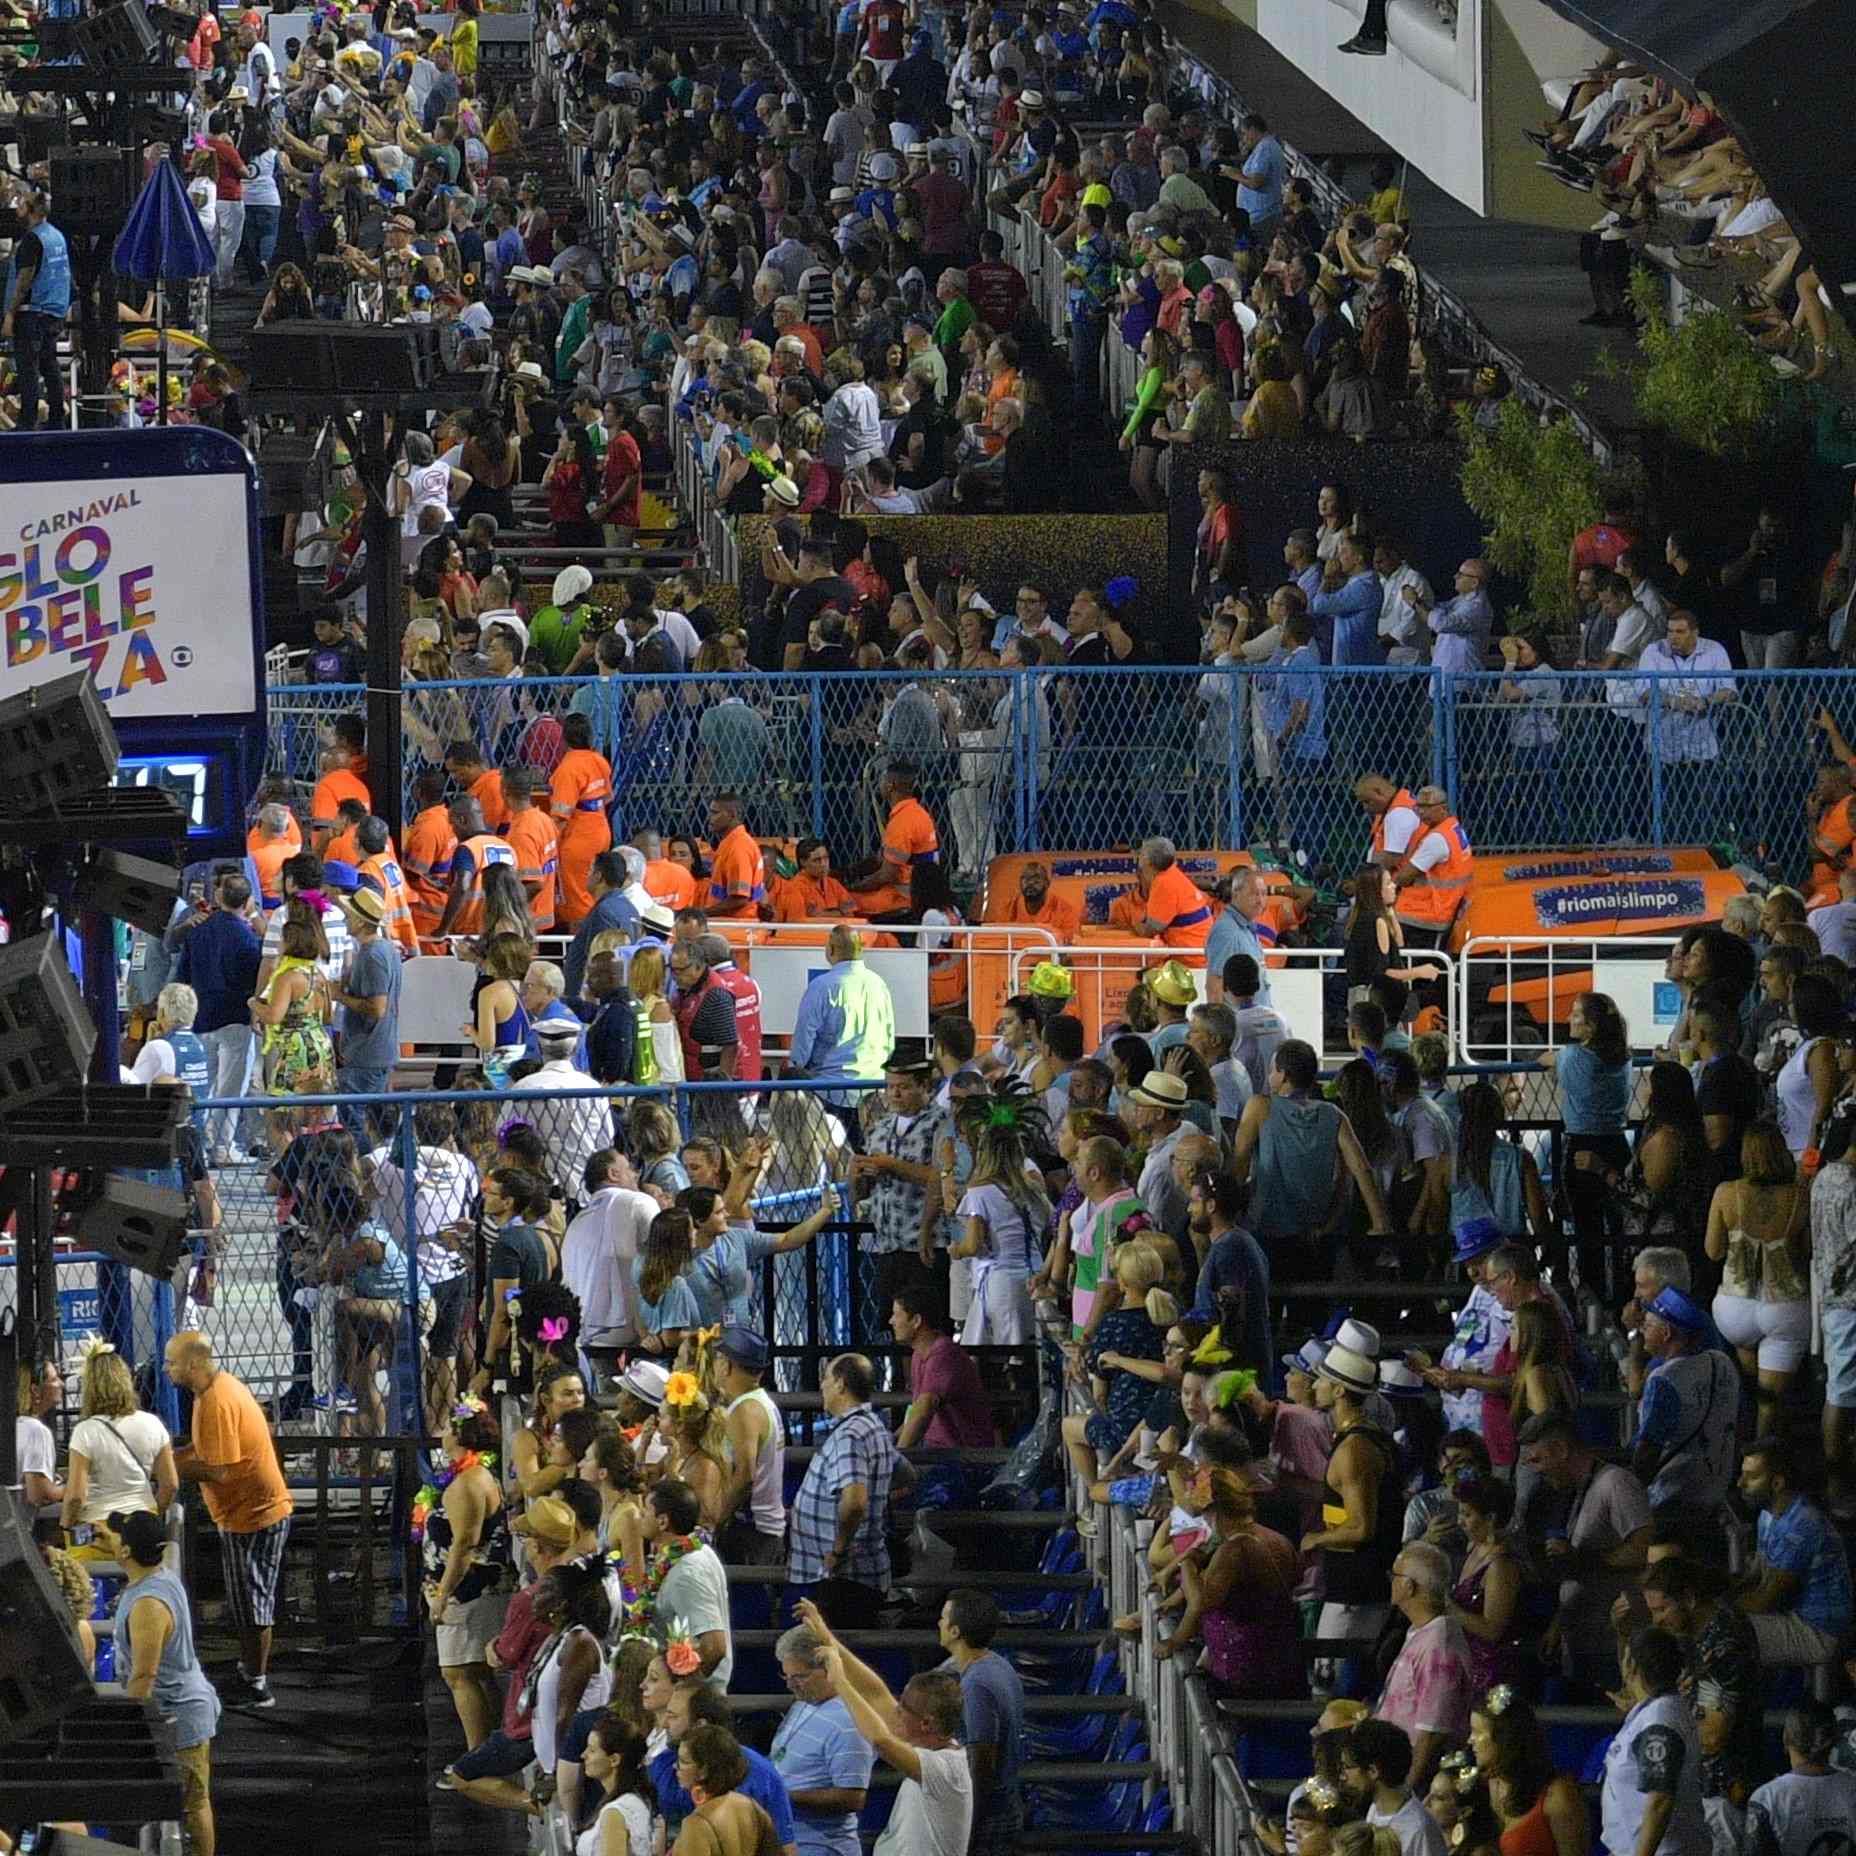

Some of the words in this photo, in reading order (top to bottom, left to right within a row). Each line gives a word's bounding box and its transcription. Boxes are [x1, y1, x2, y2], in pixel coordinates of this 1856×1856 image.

[19, 488, 143, 543] CARNAVAL
[5, 564, 157, 668] BELE
[69, 628, 168, 702] ZA
[1557, 891, 1679, 914] #riomaislimpo
